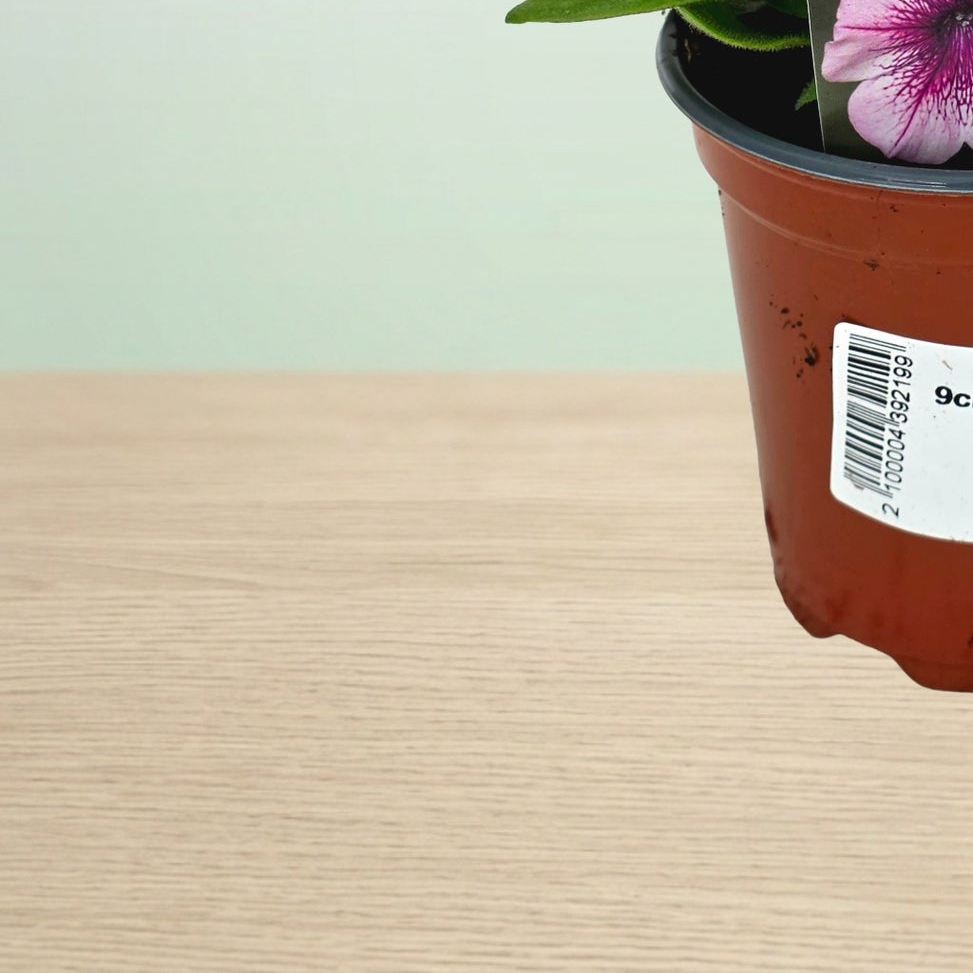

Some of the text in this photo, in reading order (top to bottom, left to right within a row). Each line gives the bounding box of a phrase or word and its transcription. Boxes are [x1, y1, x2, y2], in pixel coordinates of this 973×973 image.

[881, 354, 914, 518] 2 100004 392199
